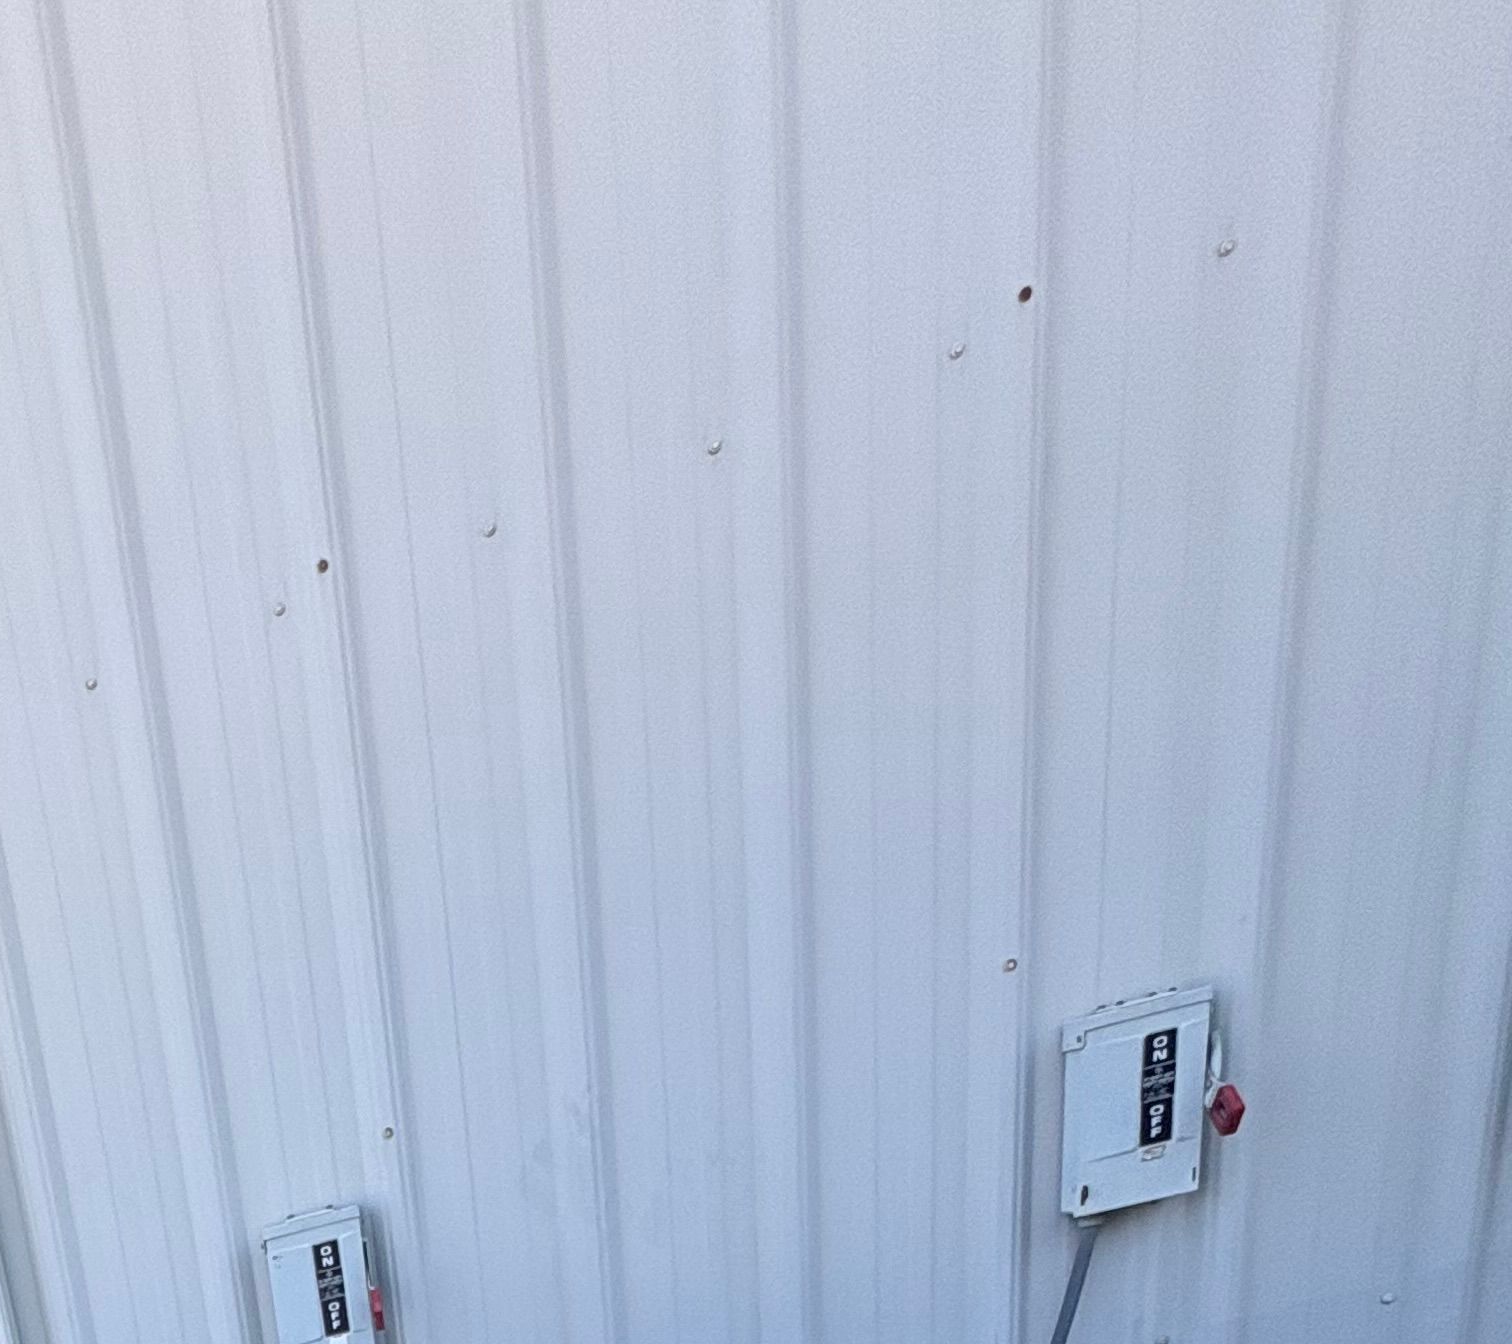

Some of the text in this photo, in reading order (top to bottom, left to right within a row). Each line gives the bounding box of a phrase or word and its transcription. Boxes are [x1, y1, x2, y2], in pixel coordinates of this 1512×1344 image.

[1152, 1035, 1169, 1063] ON
[1149, 1103, 1165, 1139] OFF
[319, 1245, 335, 1268] ON
[327, 1301, 342, 1330] OFF
